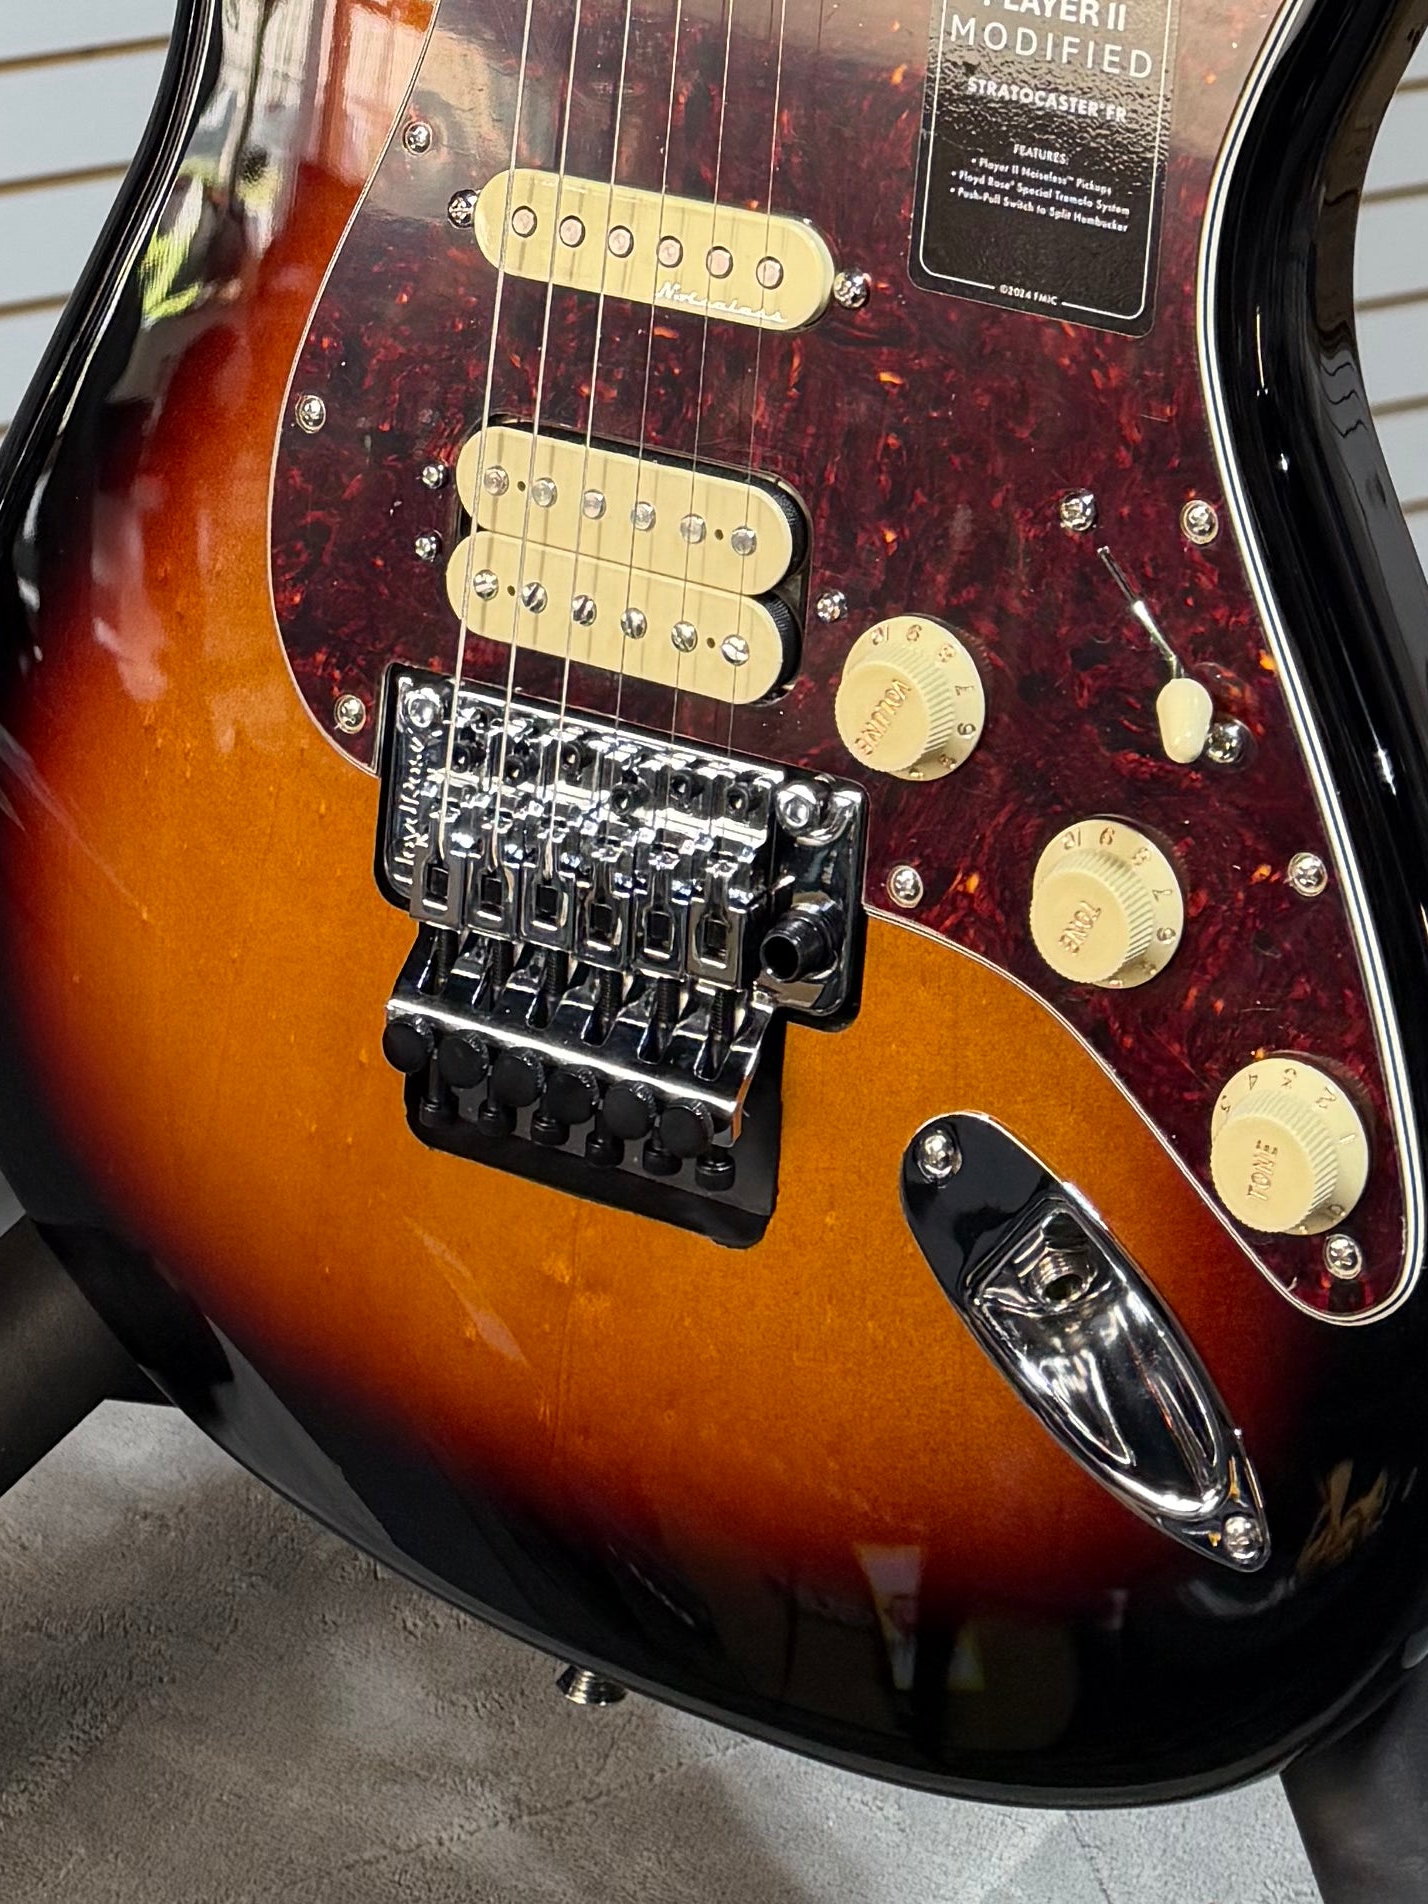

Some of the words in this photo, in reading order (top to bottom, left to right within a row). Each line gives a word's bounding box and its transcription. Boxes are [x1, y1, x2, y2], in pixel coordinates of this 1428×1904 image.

[1107, 2, 1127, 32] II
[950, 14, 1153, 79] MODIFIED
[1106, 104, 1128, 123] FR
[978, 157, 1009, 173] Player
[958, 169, 986, 186] Floyd
[1016, 182, 1052, 197] Special
[1055, 190, 1093, 208] Tremolo
[1096, 199, 1130, 216] System
[1036, 204, 1047, 215] to
[854, 678, 912, 756] VOLUME
[1058, 899, 1102, 954] TONE
[1246, 1139, 1279, 1202] TONE
